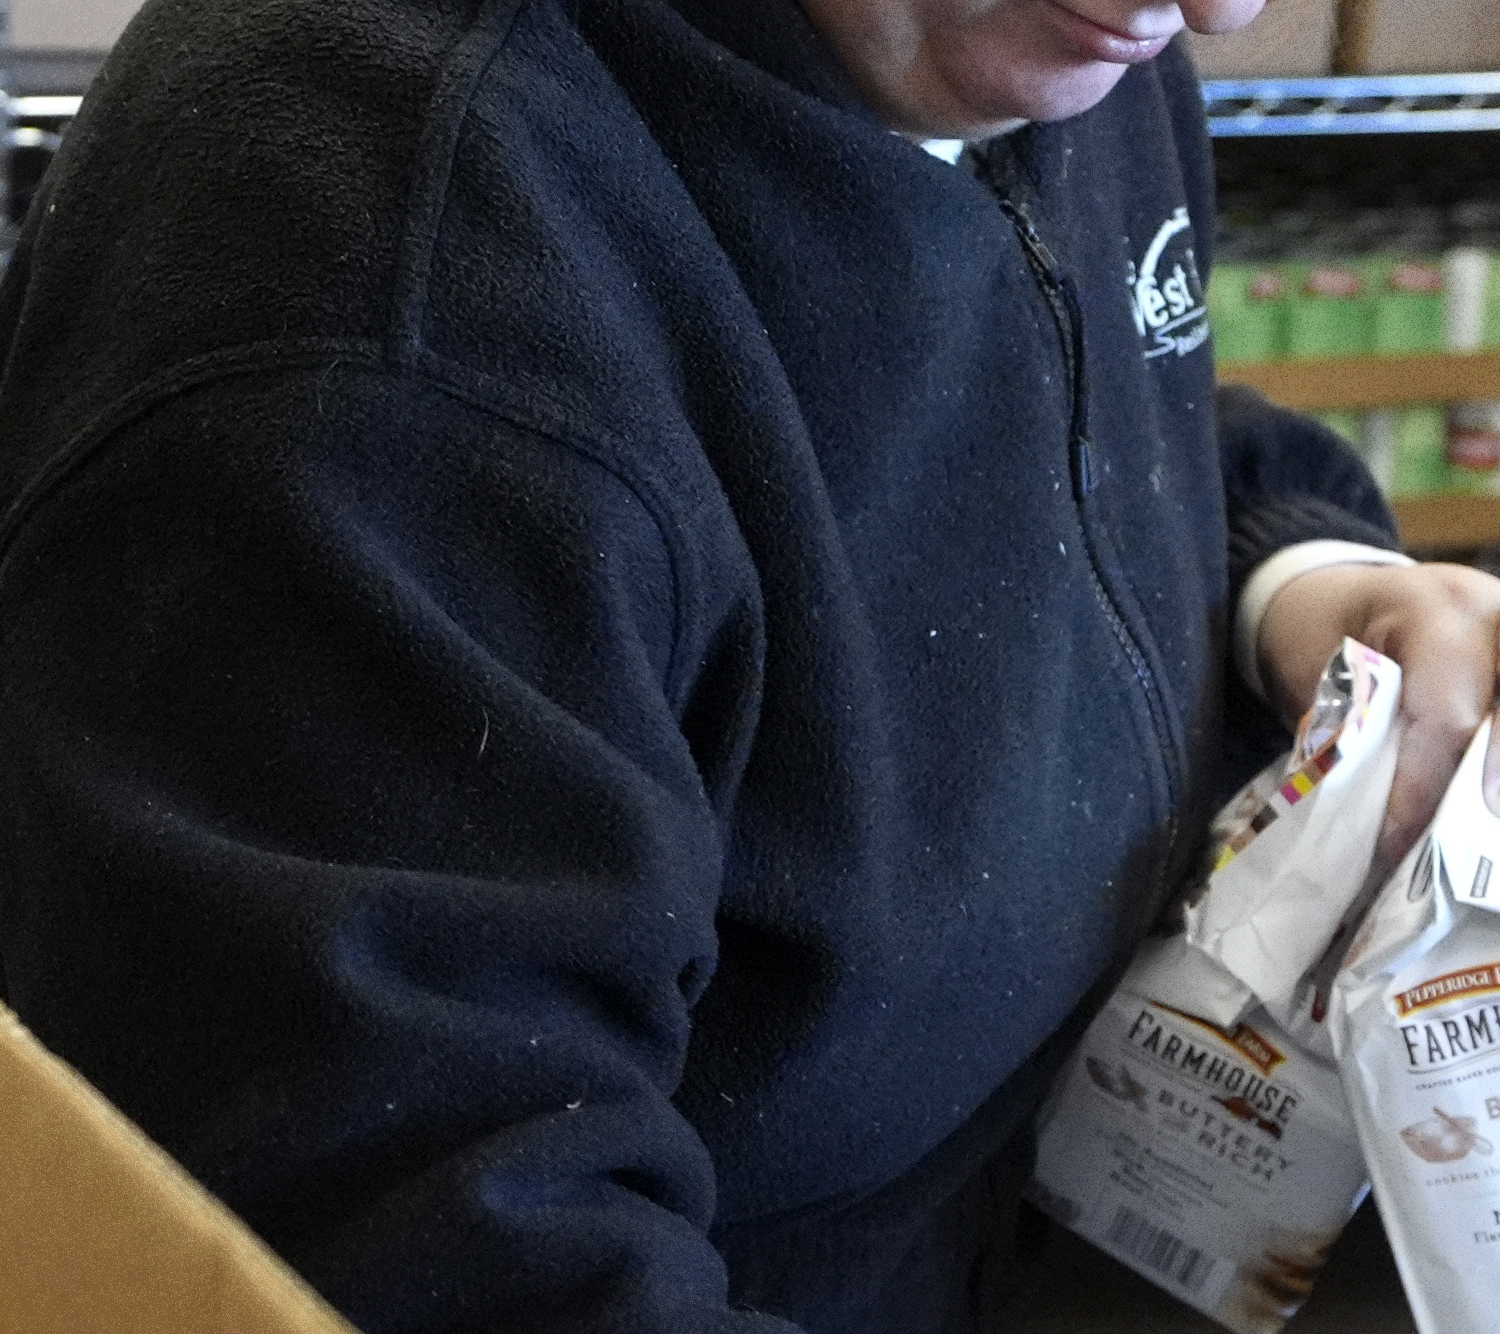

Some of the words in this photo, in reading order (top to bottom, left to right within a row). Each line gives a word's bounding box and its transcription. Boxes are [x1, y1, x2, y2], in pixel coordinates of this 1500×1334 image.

[1403, 969, 1491, 1009] PEPPERIDGE
[1126, 1009, 1297, 1123] FARMHOUSE
[1158, 1088, 1296, 1172] BUTTERY
[1198, 1130, 1276, 1182] RICH
